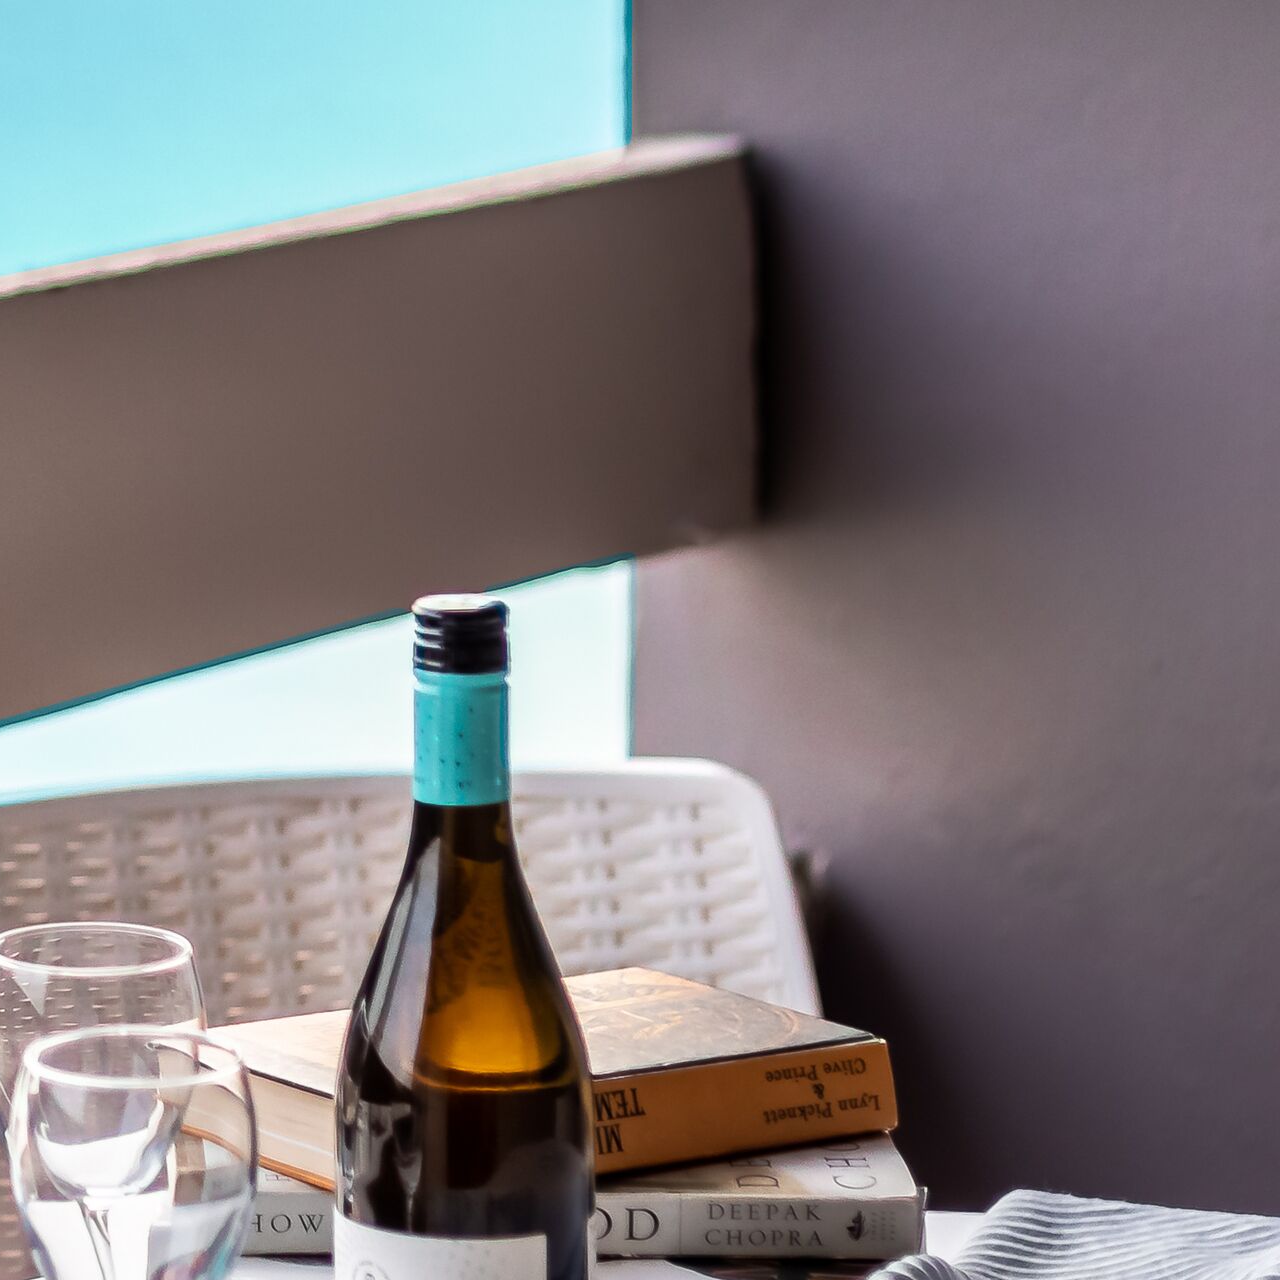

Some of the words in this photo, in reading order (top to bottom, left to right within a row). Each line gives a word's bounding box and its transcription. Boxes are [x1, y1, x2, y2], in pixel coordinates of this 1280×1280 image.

[765, 1064, 819, 1082] Prince
[822, 1057, 867, 1076] Clive
[812, 1082, 825, 1100] &
[593, 1087, 647, 1122] TEM
[837, 1092, 881, 1111] Lynn
[762, 1101, 834, 1124] Picknett
[708, 1202, 823, 1221] DEEPAK
[704, 1228, 824, 1247] CHOPRA
